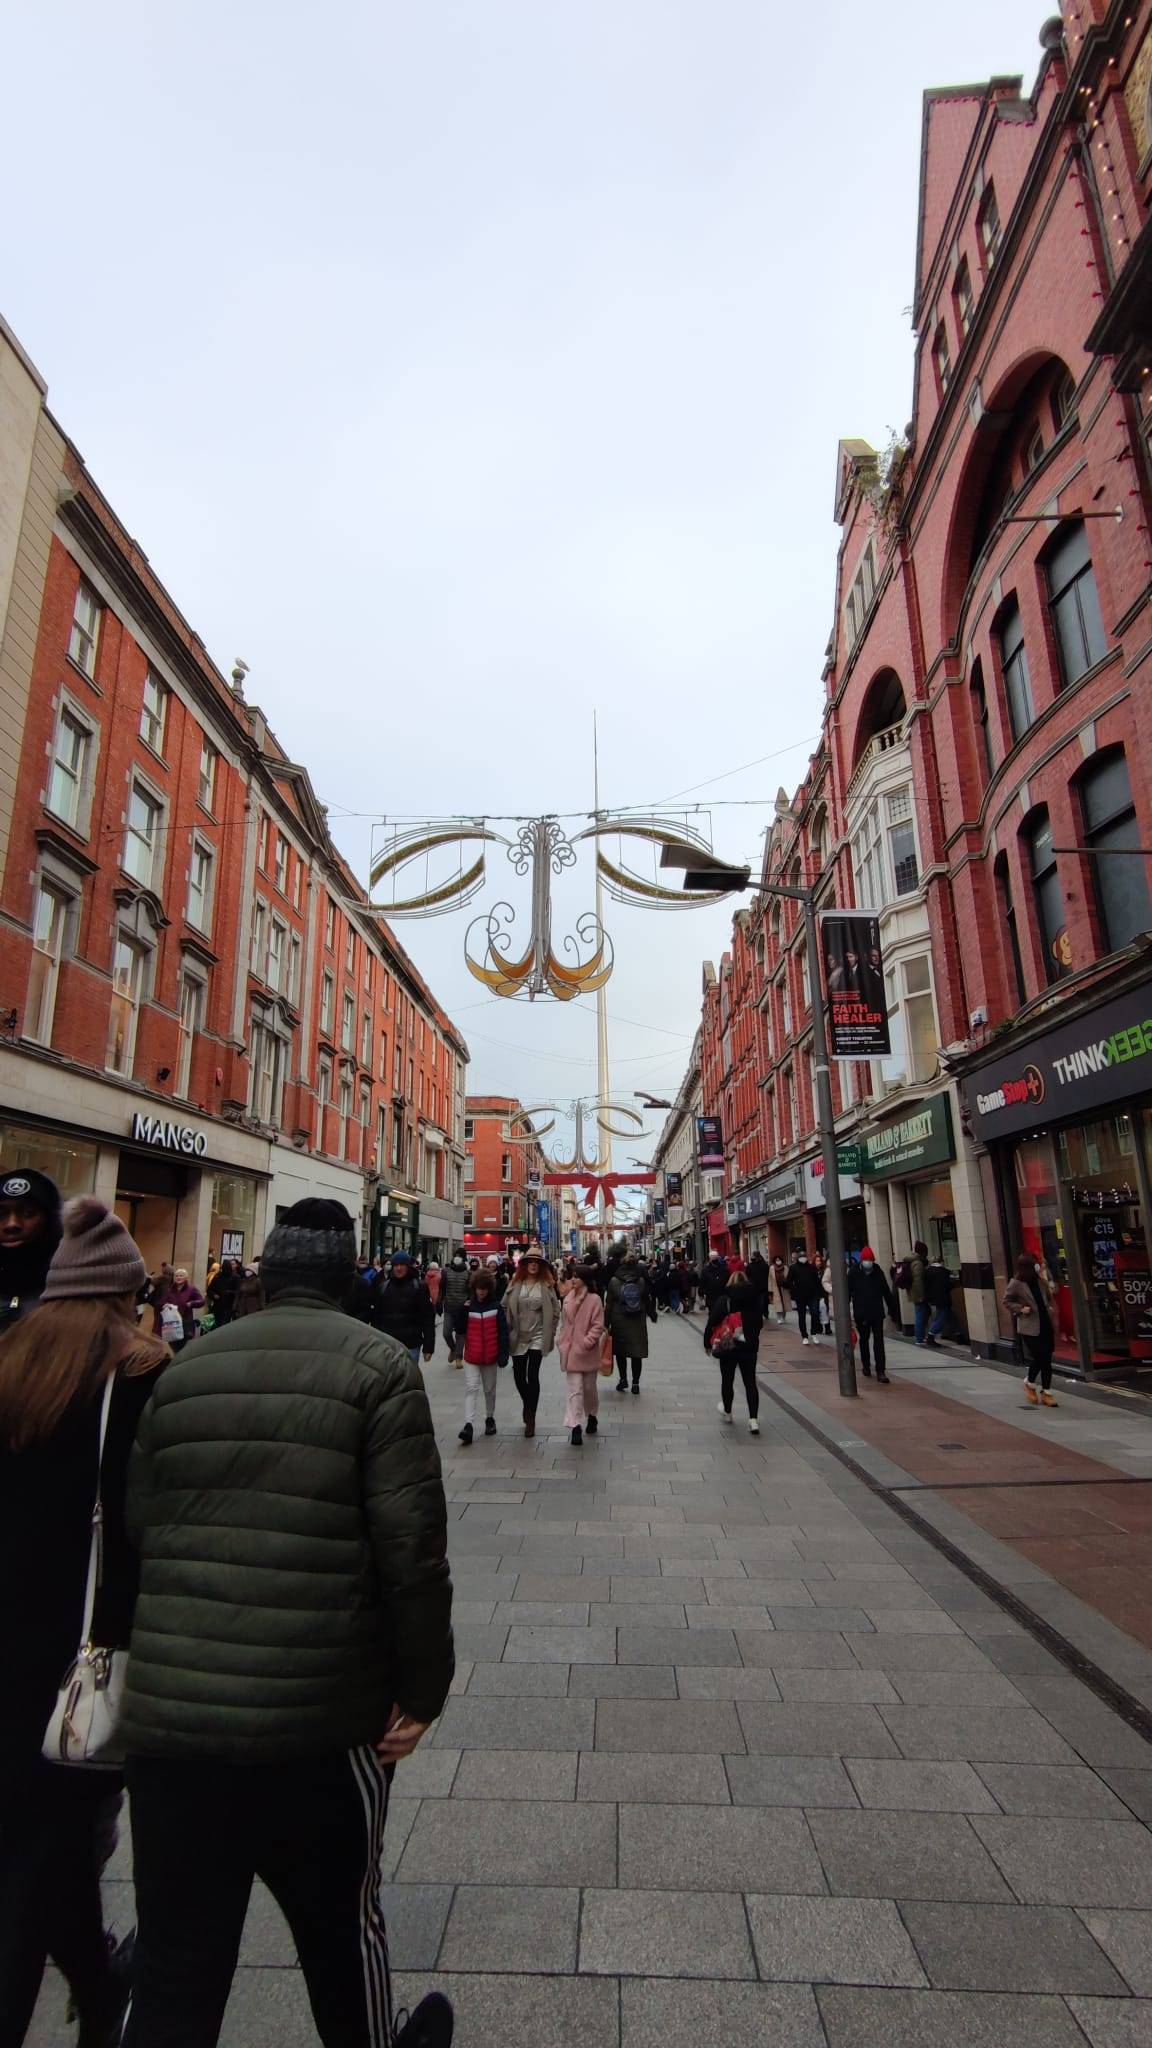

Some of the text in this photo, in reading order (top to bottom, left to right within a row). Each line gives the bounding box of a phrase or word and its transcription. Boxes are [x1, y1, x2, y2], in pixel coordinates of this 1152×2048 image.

[833, 1004, 868, 1014] FAITH
[833, 1013, 882, 1024] HEALER
[976, 1078, 1029, 1115] GameStop
[132, 1112, 208, 1156] MANGO
[1094, 1224, 1114, 1235] €15
[1125, 1292, 1147, 1305] Off
